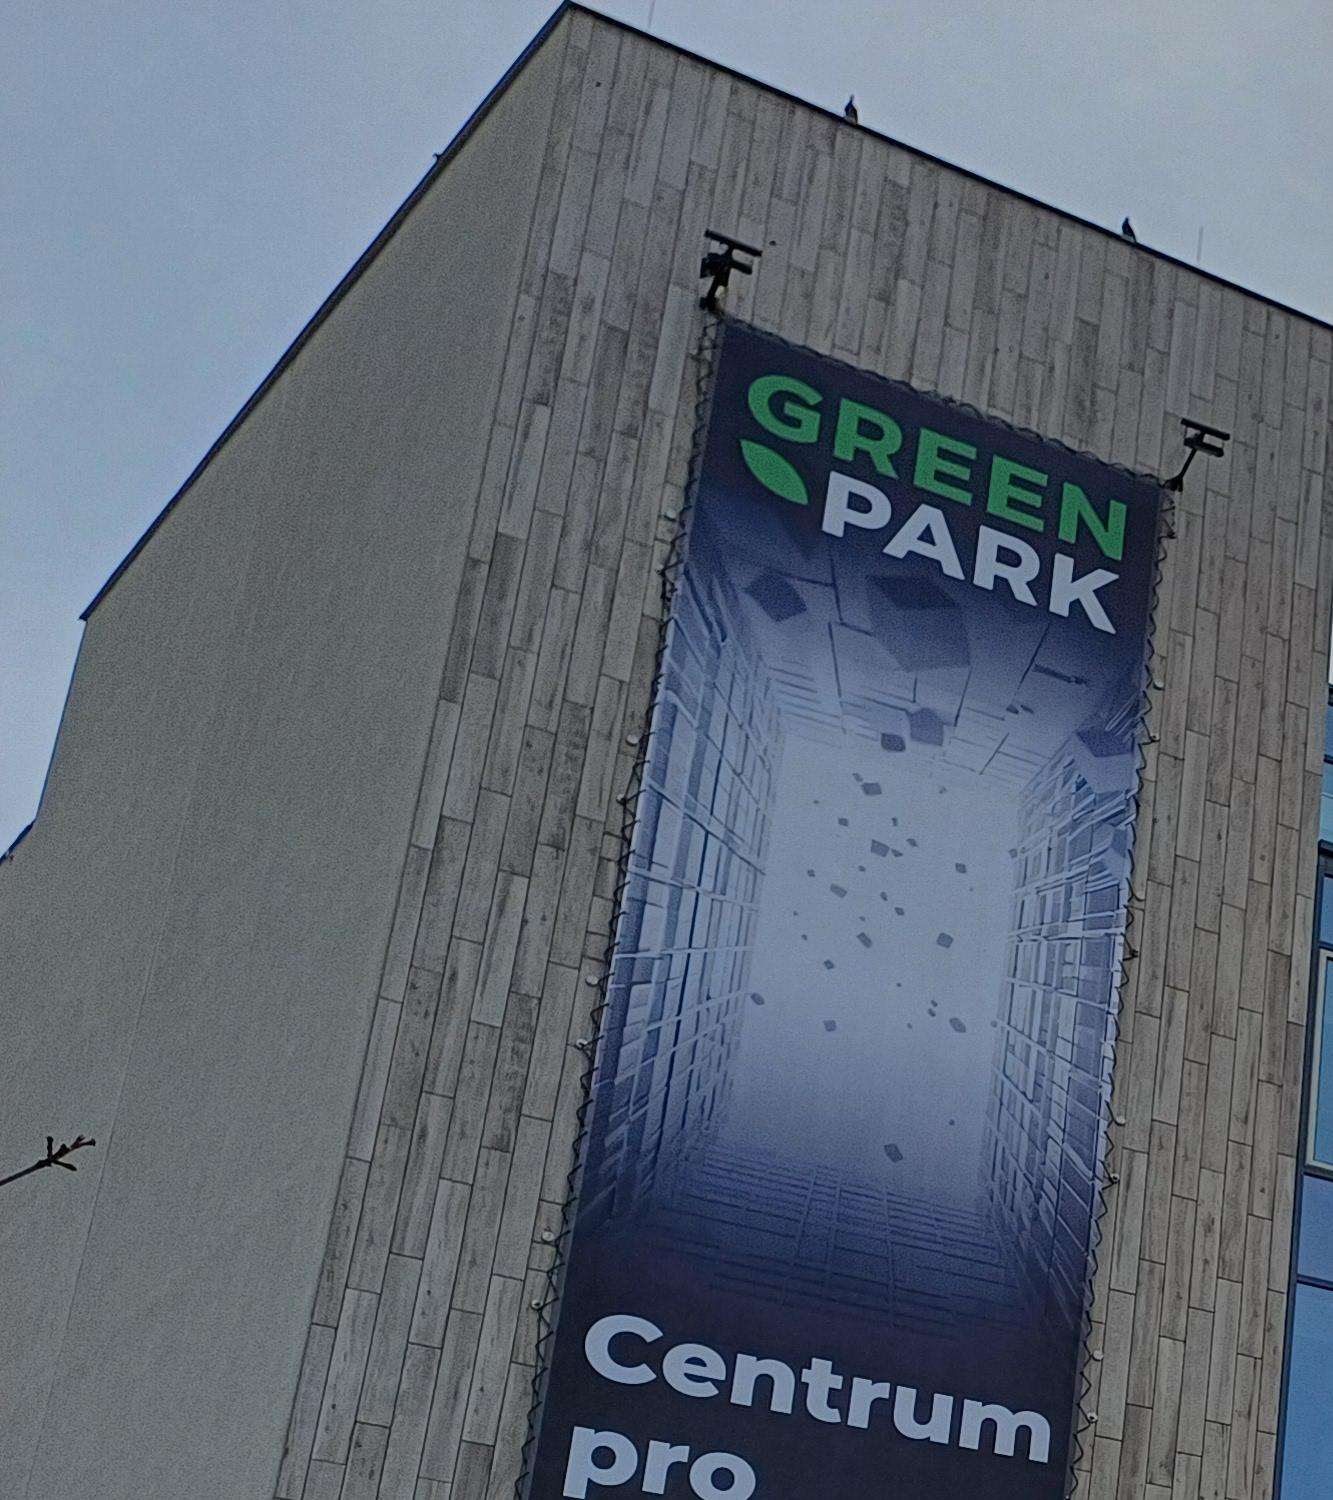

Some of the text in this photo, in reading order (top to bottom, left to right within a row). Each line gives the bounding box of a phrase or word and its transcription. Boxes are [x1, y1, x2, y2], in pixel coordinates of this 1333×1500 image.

[747, 374, 1127, 560] GREEN
[821, 471, 1120, 635] PARK
[584, 1313, 1052, 1464] Centrum
